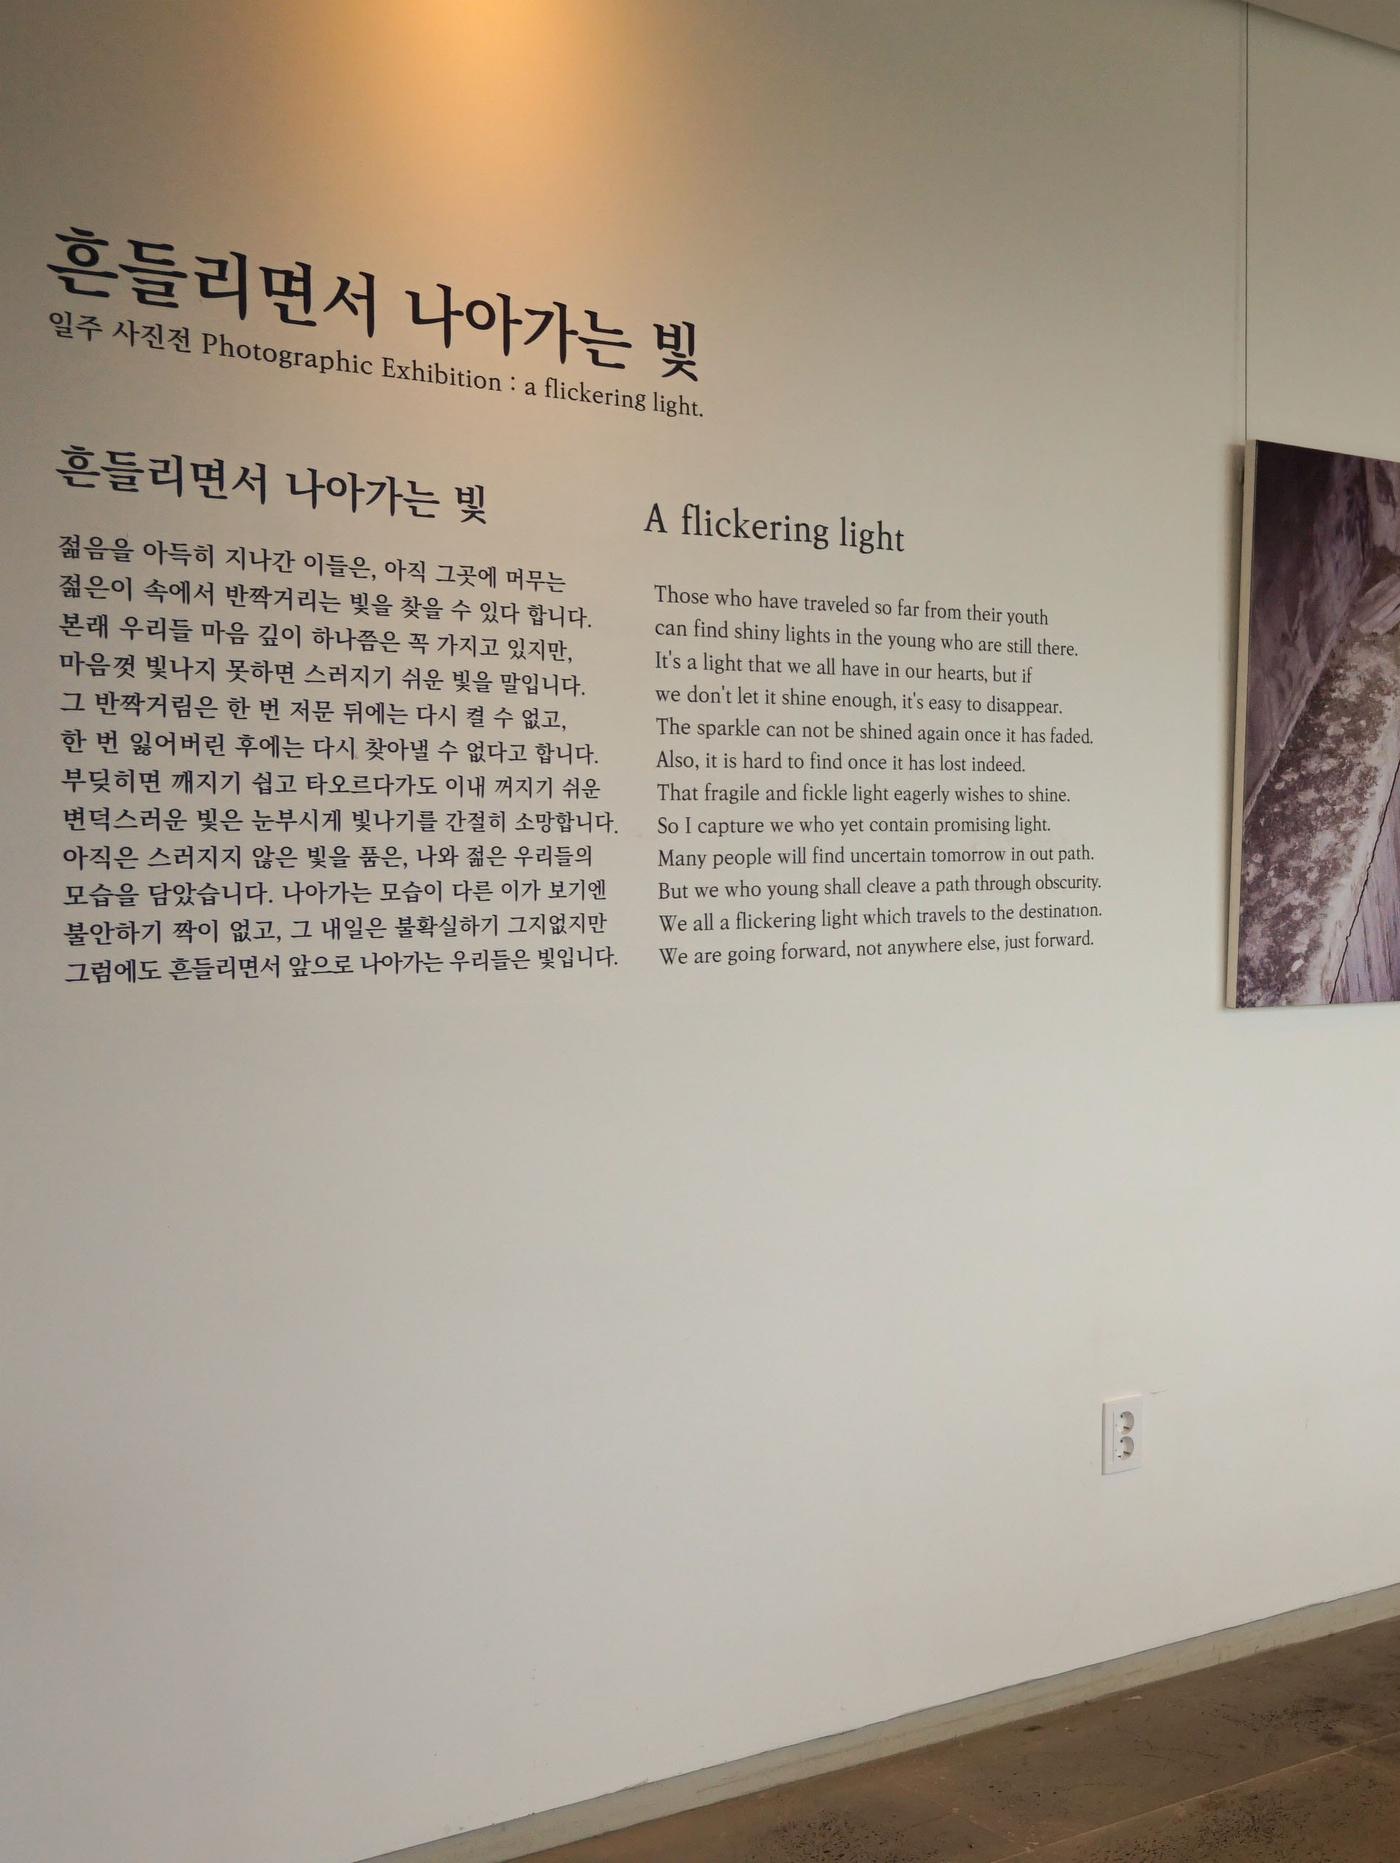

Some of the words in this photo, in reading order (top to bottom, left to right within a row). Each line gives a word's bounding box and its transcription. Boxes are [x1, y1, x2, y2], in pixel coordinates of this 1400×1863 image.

[45, 226, 376, 339] 흔들리면서
[404, 282, 633, 370] 나아가는
[652, 320, 699, 383] 빛
[48, 310, 104, 343] 일주
[111, 319, 192, 354] 사진전
[200, 332, 373, 376] Photographic
[381, 356, 503, 392] Exhibition
[524, 381, 537, 397] a
[544, 376, 647, 412] flickering
[652, 391, 704, 418] light.
[55, 444, 267, 506] 흔들리면서
[285, 467, 441, 519] 나아가는
[454, 484, 487, 525] 빛
[643, 502, 669, 534] A
[681, 502, 829, 551] flickering
[839, 515, 905, 555] light
[58, 533, 135, 563] 젊음을
[142, 539, 214, 569] 아득히
[225, 546, 297, 574] 지나간
[303, 551, 377, 582] 이들은,
[384, 558, 426, 584] 아직
[434, 564, 497, 590] 그곳에
[505, 567, 567, 593] 머무는
[653, 584, 710, 605] Those
[714, 587, 753, 608] who
[758, 589, 799, 610] have
[803, 594, 870, 614] traveled
[874, 602, 892, 616] so
[897, 598, 920, 617] far
[924, 599, 962, 620] from
[966, 603, 1003, 623] their
[1006, 608, 1049, 627] youth
[58, 650, 136, 679] 마음껏
[144, 654, 215, 683] 빛나지
[225, 659, 296, 685] 못하면
[303, 663, 391, 690] 스러지기
[401, 666, 445, 691] 쉬운
[451, 669, 494, 694] 빛을
[499, 671, 586, 698] 말입니다.
[655, 689, 681, 703] we
[686, 684, 733, 704] don't
[737, 685, 759, 705] let
[765, 688, 777, 705] it
[781, 687, 827, 707] shine
[831, 690, 897, 712] enough,
[902, 691, 924, 710] it's
[928, 698, 962, 715] easy
[966, 698, 982, 712] to
[986, 695, 1063, 717] disappear.
[59, 728, 88, 754] 한
[95, 729, 120, 755] 번
[129, 730, 226, 758] 잃어버린
[234, 733, 305, 760] 후에는
[312, 735, 359, 761] 다시
[364, 737, 430, 762] 찾아낼
[437, 739, 460, 763] 수
[466, 740, 528, 765] 없다고
[534, 742, 599, 766] 합니다.
[60, 767, 162, 795] 부딪히면
[170, 769, 241, 796] 깨지기
[251, 770, 298, 796] 쉽고
[305, 771, 438, 798] 타오르다가도
[445, 774, 486, 799] 이내
[494, 775, 553, 800] 꺼지기
[561, 776, 601, 800] 쉬운
[656, 782, 699, 802] That
[704, 782, 760, 805] fragile
[765, 783, 798, 802] and
[803, 782, 848, 801] fickle
[852, 783, 889, 805] light
[893, 784, 951, 805] eagerly
[954, 784, 1005, 802] wishes
[1008, 789, 1024, 802] to
[1028, 785, 1071, 803] shine.
[657, 816, 679, 835] So
[685, 816, 692, 834] I
[697, 819, 765, 838] capture
[769, 820, 794, 833] we
[798, 814, 835, 833] who
[839, 819, 865, 836] yet
[869, 817, 929, 833] contain
[934, 816, 1011, 836] promising
[1014, 814, 1051, 835] light.
[62, 845, 140, 872] 아직은
[146, 844, 241, 871] 스러지지
[252, 844, 299, 870] 않은
[306, 844, 351, 870] 빛을
[357, 845, 408, 870] 품은,
[415, 844, 460, 869] 나와
[465, 844, 508, 868] 젊은
[513, 844, 592, 868] 우리들의
[657, 848, 708, 870] Many
[711, 846, 772, 870] people
[777, 846, 807, 865] will
[812, 845, 845, 864] find
[850, 847, 927, 864] uncertain
[931, 849, 1007, 863] tomorrow
[1011, 846, 1025, 862] in
[1029, 847, 1054, 861] out
[1058, 843, 1094, 864] path.
[62, 882, 141, 908] 모습을
[147, 881, 274, 908] 담았습니다.
[281, 880, 373, 906] 나아가는
[379, 879, 443, 904] 모습이
[451, 879, 494, 904] 다른
[500, 878, 542, 903] 이가
[547, 878, 607, 902] 보기엔
[657, 882, 689, 900] But
[693, 885, 719, 898] we
[724, 879, 762, 898] who
[766, 883, 820, 901] young
[823, 876, 862, 896] shall
[866, 875, 917, 894] cleave
[921, 881, 931, 893] a
[935, 874, 970, 896] path
[974, 873, 1032, 894] through
[1035, 872, 1102, 892] obscurity.
[63, 919, 162, 947] 불안하기
[172, 918, 218, 944] 짝이
[229, 918, 282, 944] 없고,
[290, 920, 313, 939] 그
[320, 916, 388, 941] 내일은
[393, 913, 498, 939] 불확실하기
[507, 911, 608, 936] 그지없지만
[658, 914, 688, 933] We
[692, 912, 715, 932] all
[719, 918, 731, 931] a
[735, 910, 817, 931] flickering
[821, 908, 859, 930] light
[862, 906, 912, 925] which
[916, 904, 967, 924] travels
[970, 909, 986, 922] to
[990, 903, 1015, 921] the
[1018, 902, 1102, 920] destination.
[64, 958, 163, 985] 그럼에도
[167, 954, 280, 982] 흔들리면서
[288, 953, 355, 978] 앞으로
[359, 950, 445, 976] 나아가는
[448, 948, 532, 973] 우리들은
[537, 945, 618, 970] 빛입니다.
[658, 947, 688, 965] We
[693, 950, 722, 965] are
[727, 945, 776, 966] going
[781, 939, 851, 960] forward,
[856, 942, 883, 957] not
[887, 935, 963, 958] anywhere
[967, 933, 1000, 953] else,
[1004, 935, 1031, 952] just
[1034, 929, 1094, 948] forward.
